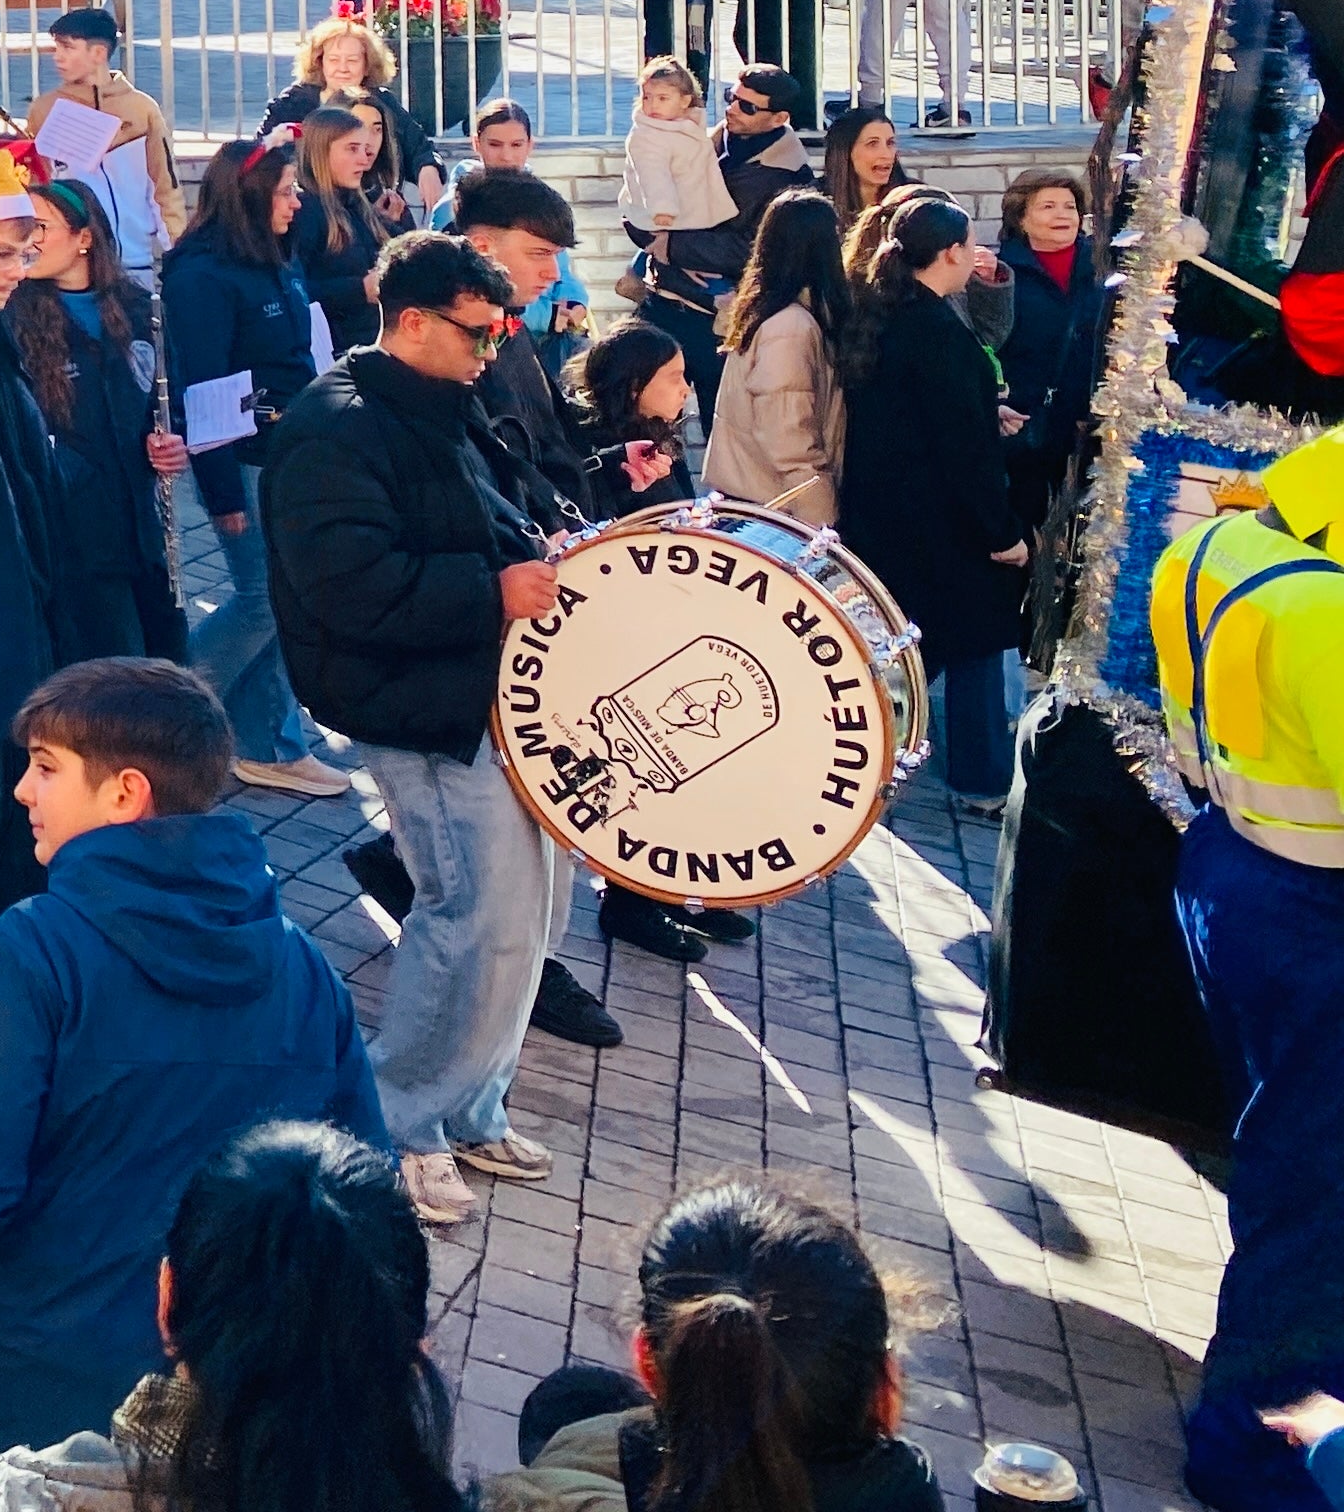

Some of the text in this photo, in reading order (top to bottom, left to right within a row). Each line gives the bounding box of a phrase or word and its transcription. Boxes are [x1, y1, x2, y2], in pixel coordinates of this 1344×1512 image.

[708, 641, 738, 661] VEGA
[626, 544, 870, 810] HUÉTOR VEGA
[762, 703, 773, 718] DE
[501, 583, 797, 884] BANDA DE MÚSICA
[661, 743, 689, 775] BANDA
